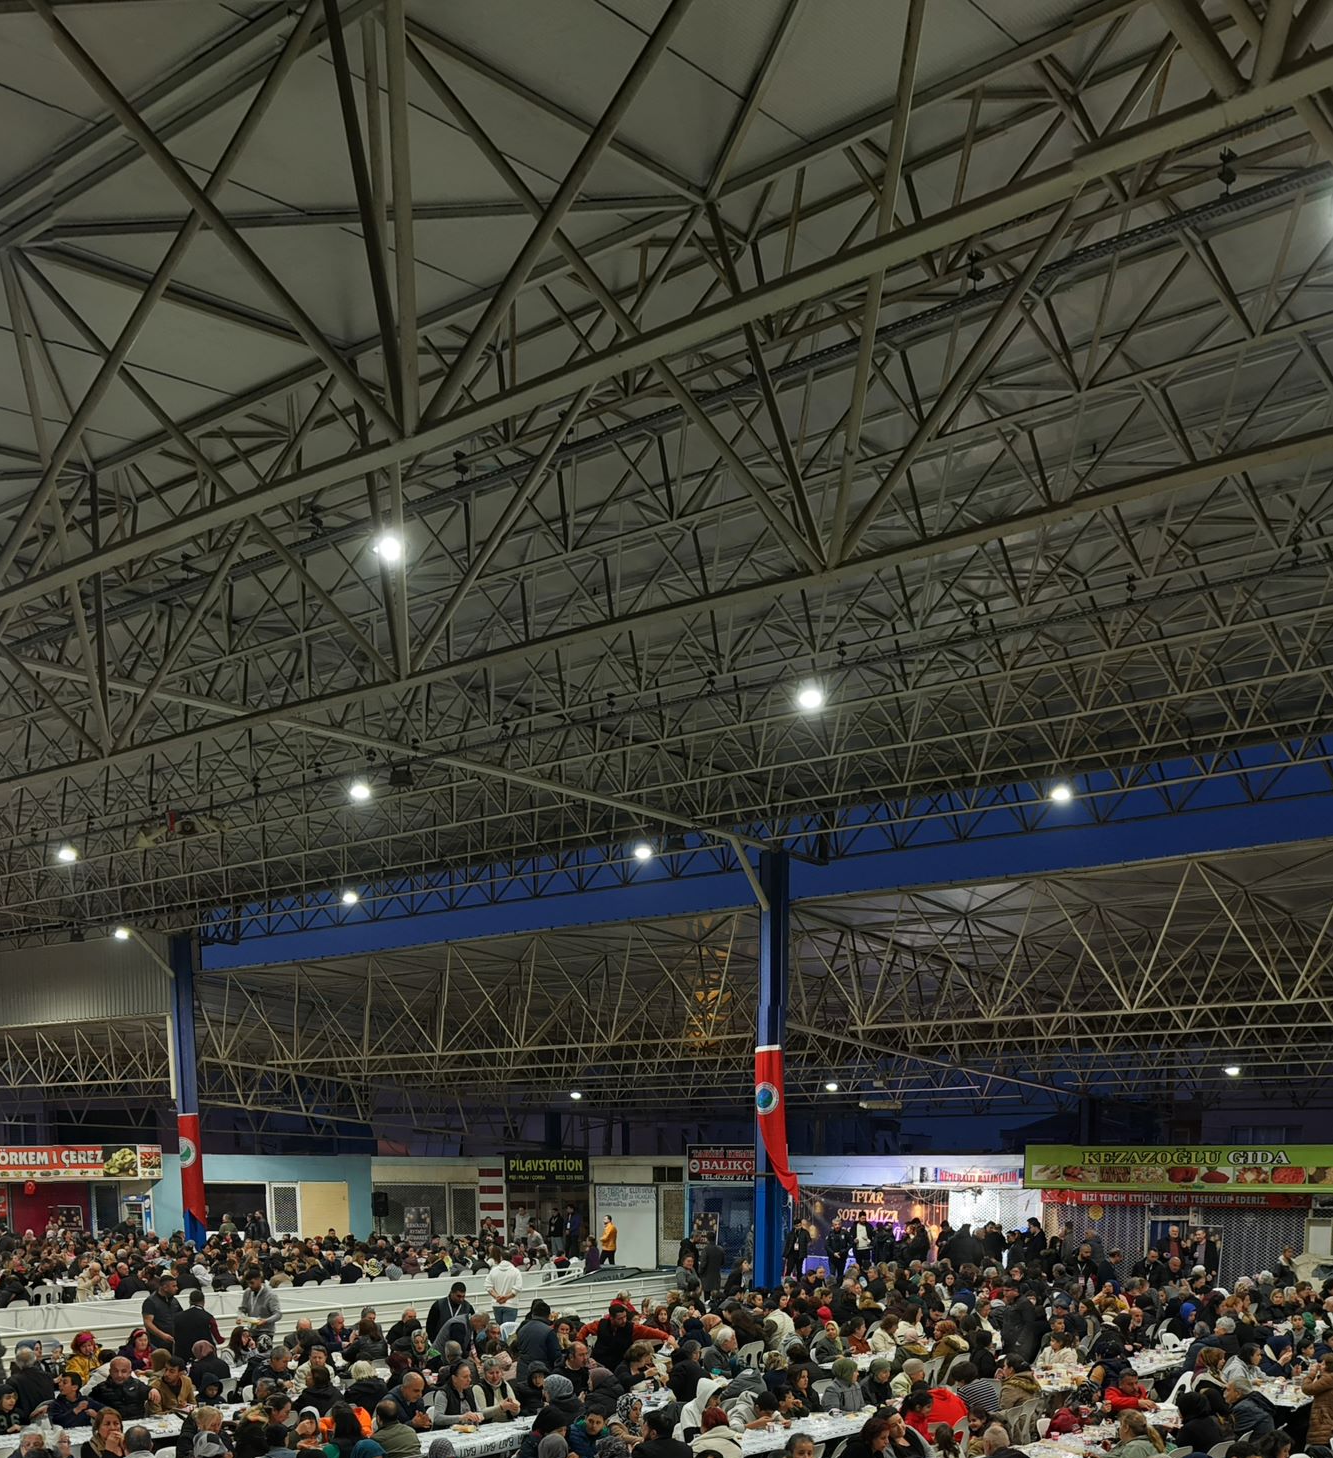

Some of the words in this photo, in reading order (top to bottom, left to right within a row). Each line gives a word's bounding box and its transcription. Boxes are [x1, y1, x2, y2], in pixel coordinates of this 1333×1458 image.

[60, 1150, 104, 1168] ÇEREZ
[1082, 1148, 1221, 1165] KEZAZOĞLU
[1227, 1150, 1290, 1165] GIDA
[851, 1188, 884, 1204] İFTAR
[1082, 1192, 1097, 1202] BİZİ
[1100, 1193, 1125, 1202] TERCİH
[1129, 1193, 1168, 1203] ETTİĞİNİZ
[1171, 1193, 1187, 1204] İÇİN
